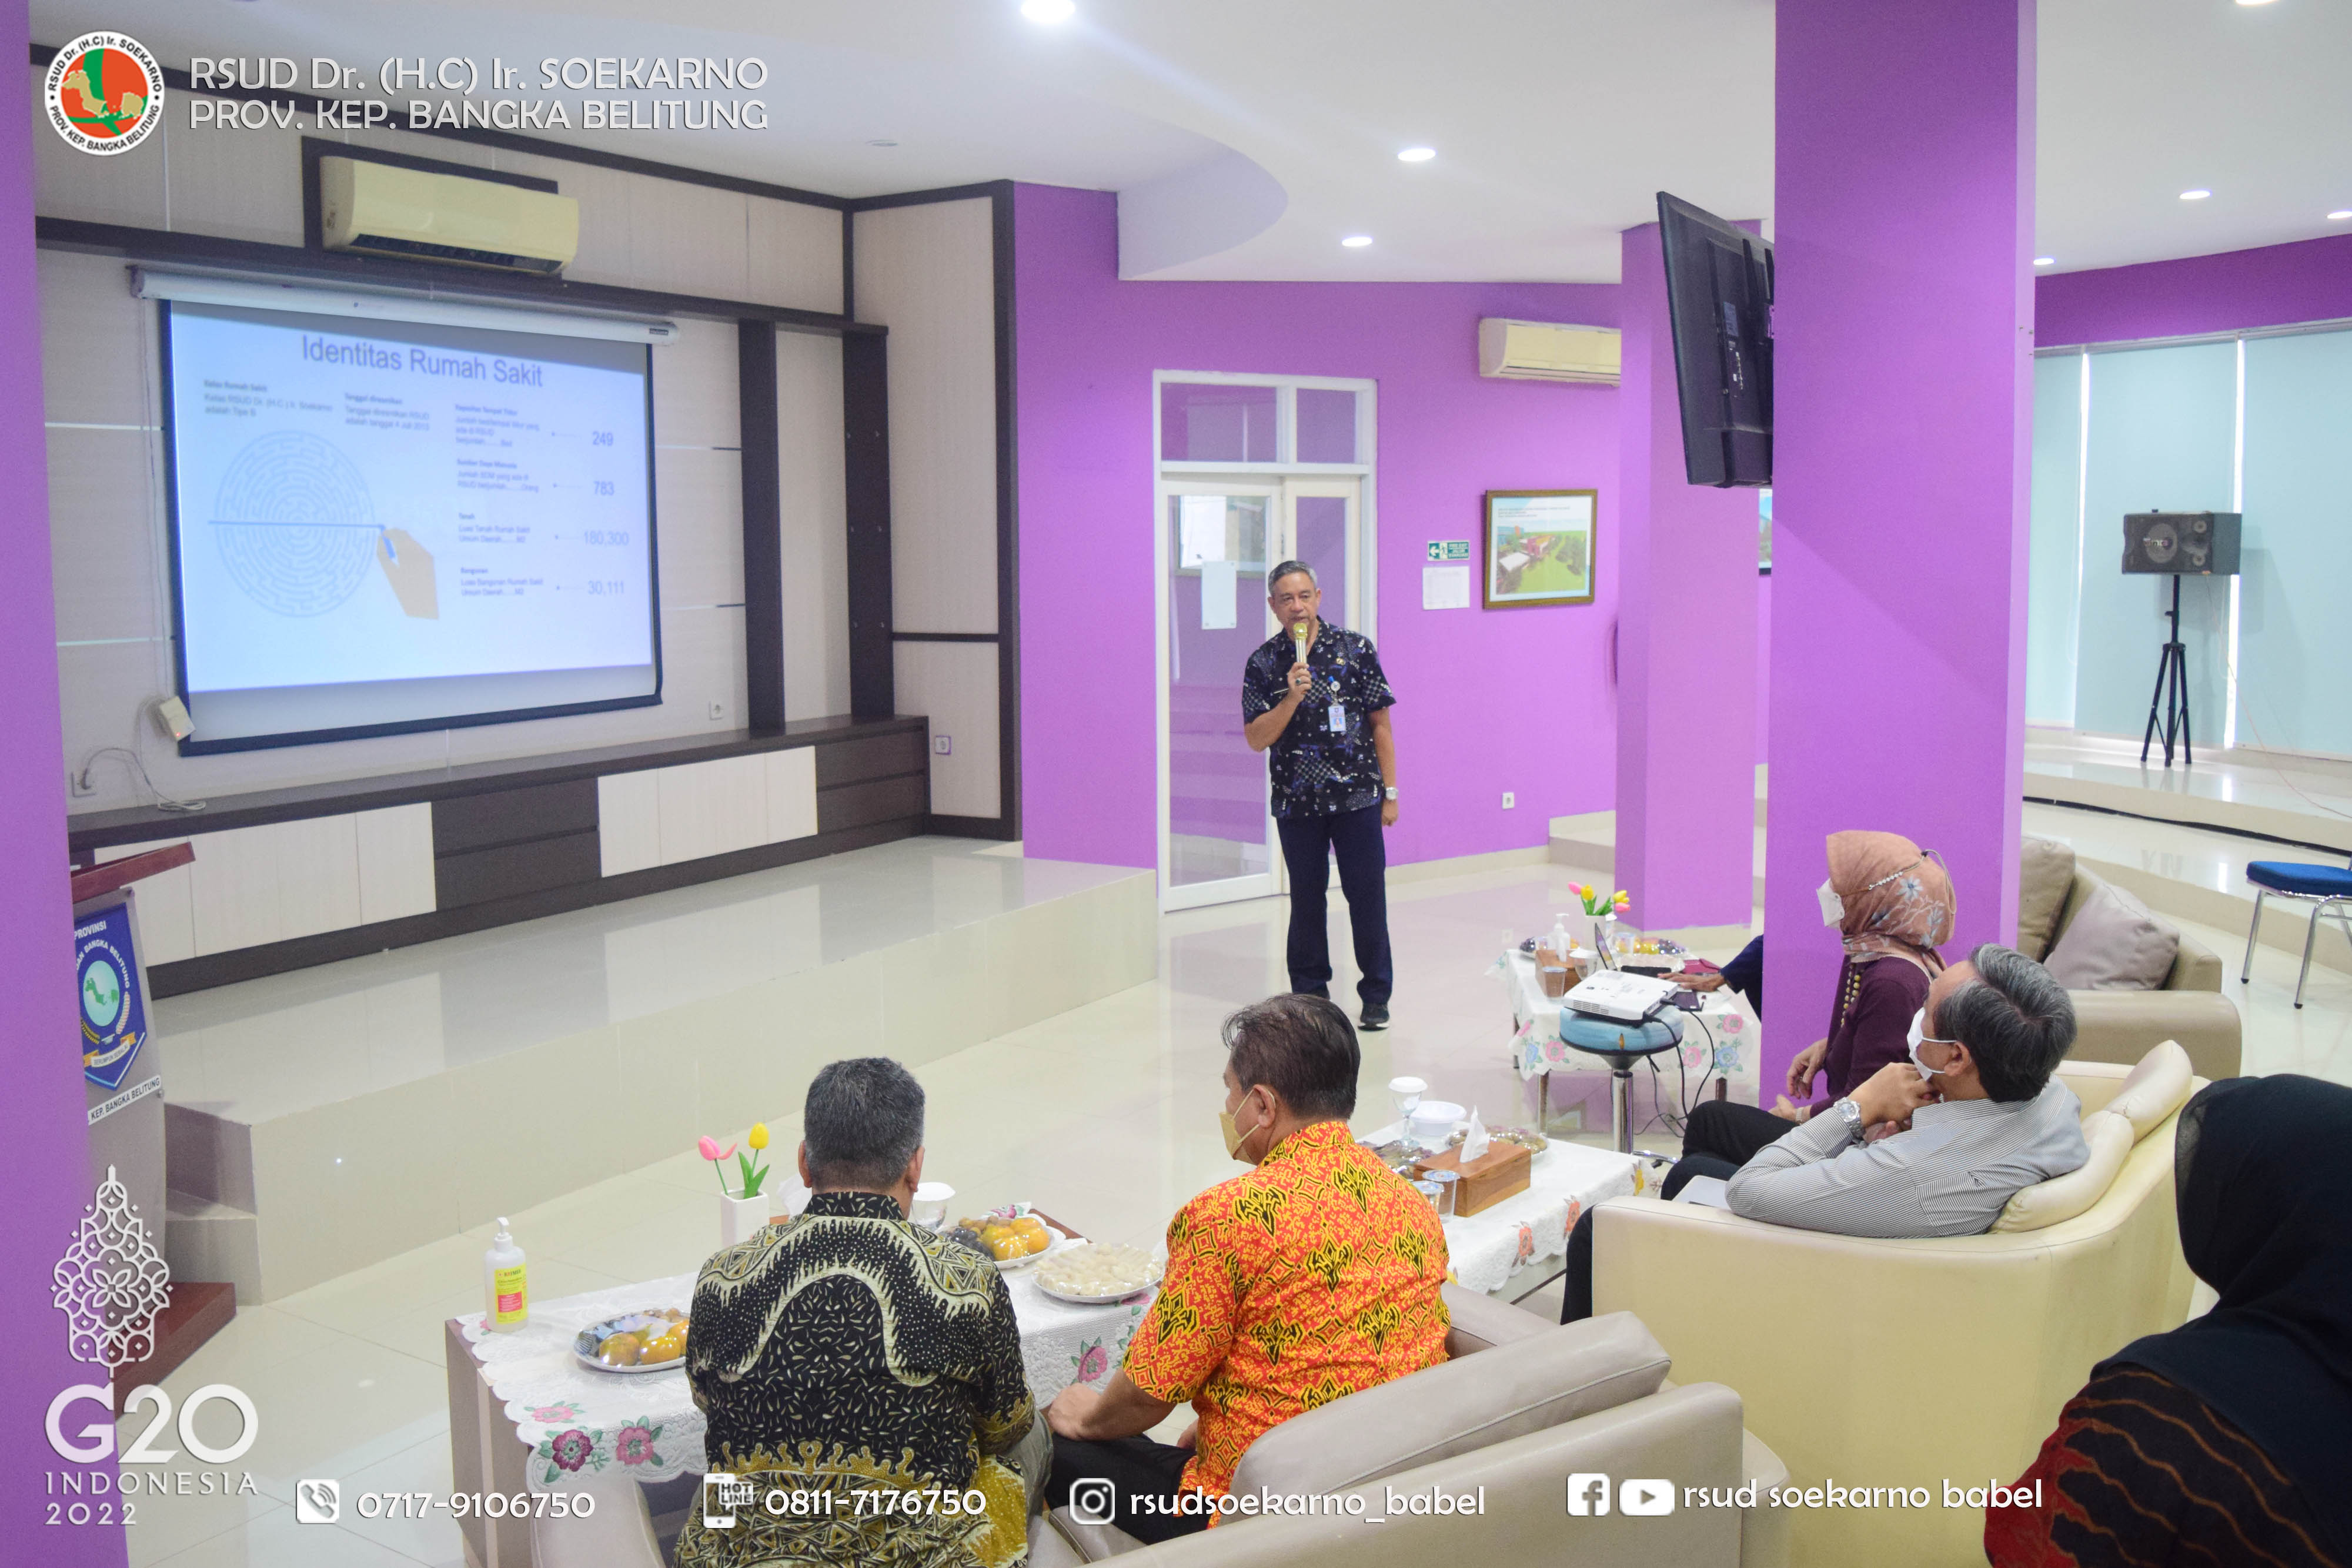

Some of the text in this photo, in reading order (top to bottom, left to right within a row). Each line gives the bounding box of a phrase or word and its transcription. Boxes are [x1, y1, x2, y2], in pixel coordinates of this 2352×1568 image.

[302, 335, 543, 387] Identitas Rumah Sakit
[592, 431, 613, 447] 249
[593, 481, 614, 496] 783
[74, 920, 107, 941] PROVINSI
[84, 940, 108, 953] BANGKA
[109, 945, 130, 988] BELITUNG
[90, 1077, 161, 1121] KEP. BANGKA BELITUNG
